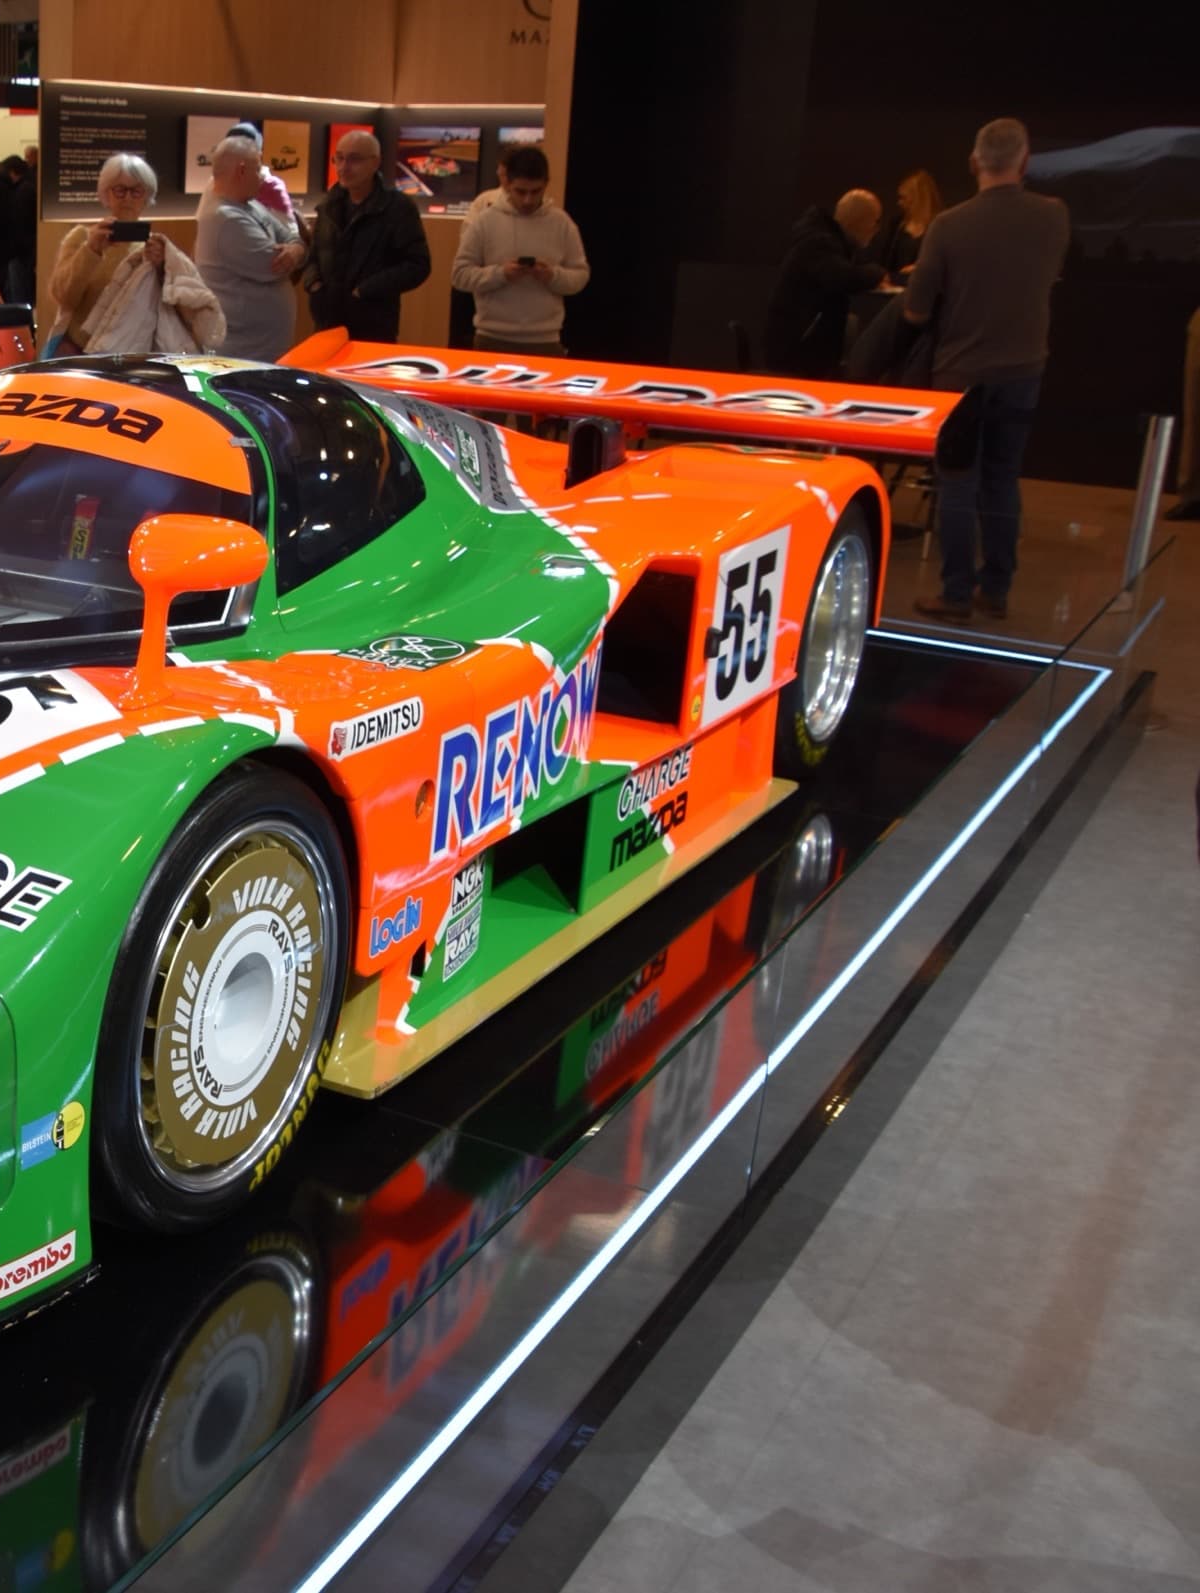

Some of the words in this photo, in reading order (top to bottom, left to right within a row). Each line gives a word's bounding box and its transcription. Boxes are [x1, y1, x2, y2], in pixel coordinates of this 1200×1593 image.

[715, 548, 779, 701] 55
[350, 701, 421, 750] IDEMITSU
[617, 742, 695, 822] CHARGE
[232, 875, 294, 914] VOLK
[268, 918, 294, 975] RAYS
[193, 1044, 223, 1100] RAYS
[21, 1131, 51, 1153] BILSTEIN
[194, 1098, 258, 1140] VOLK
